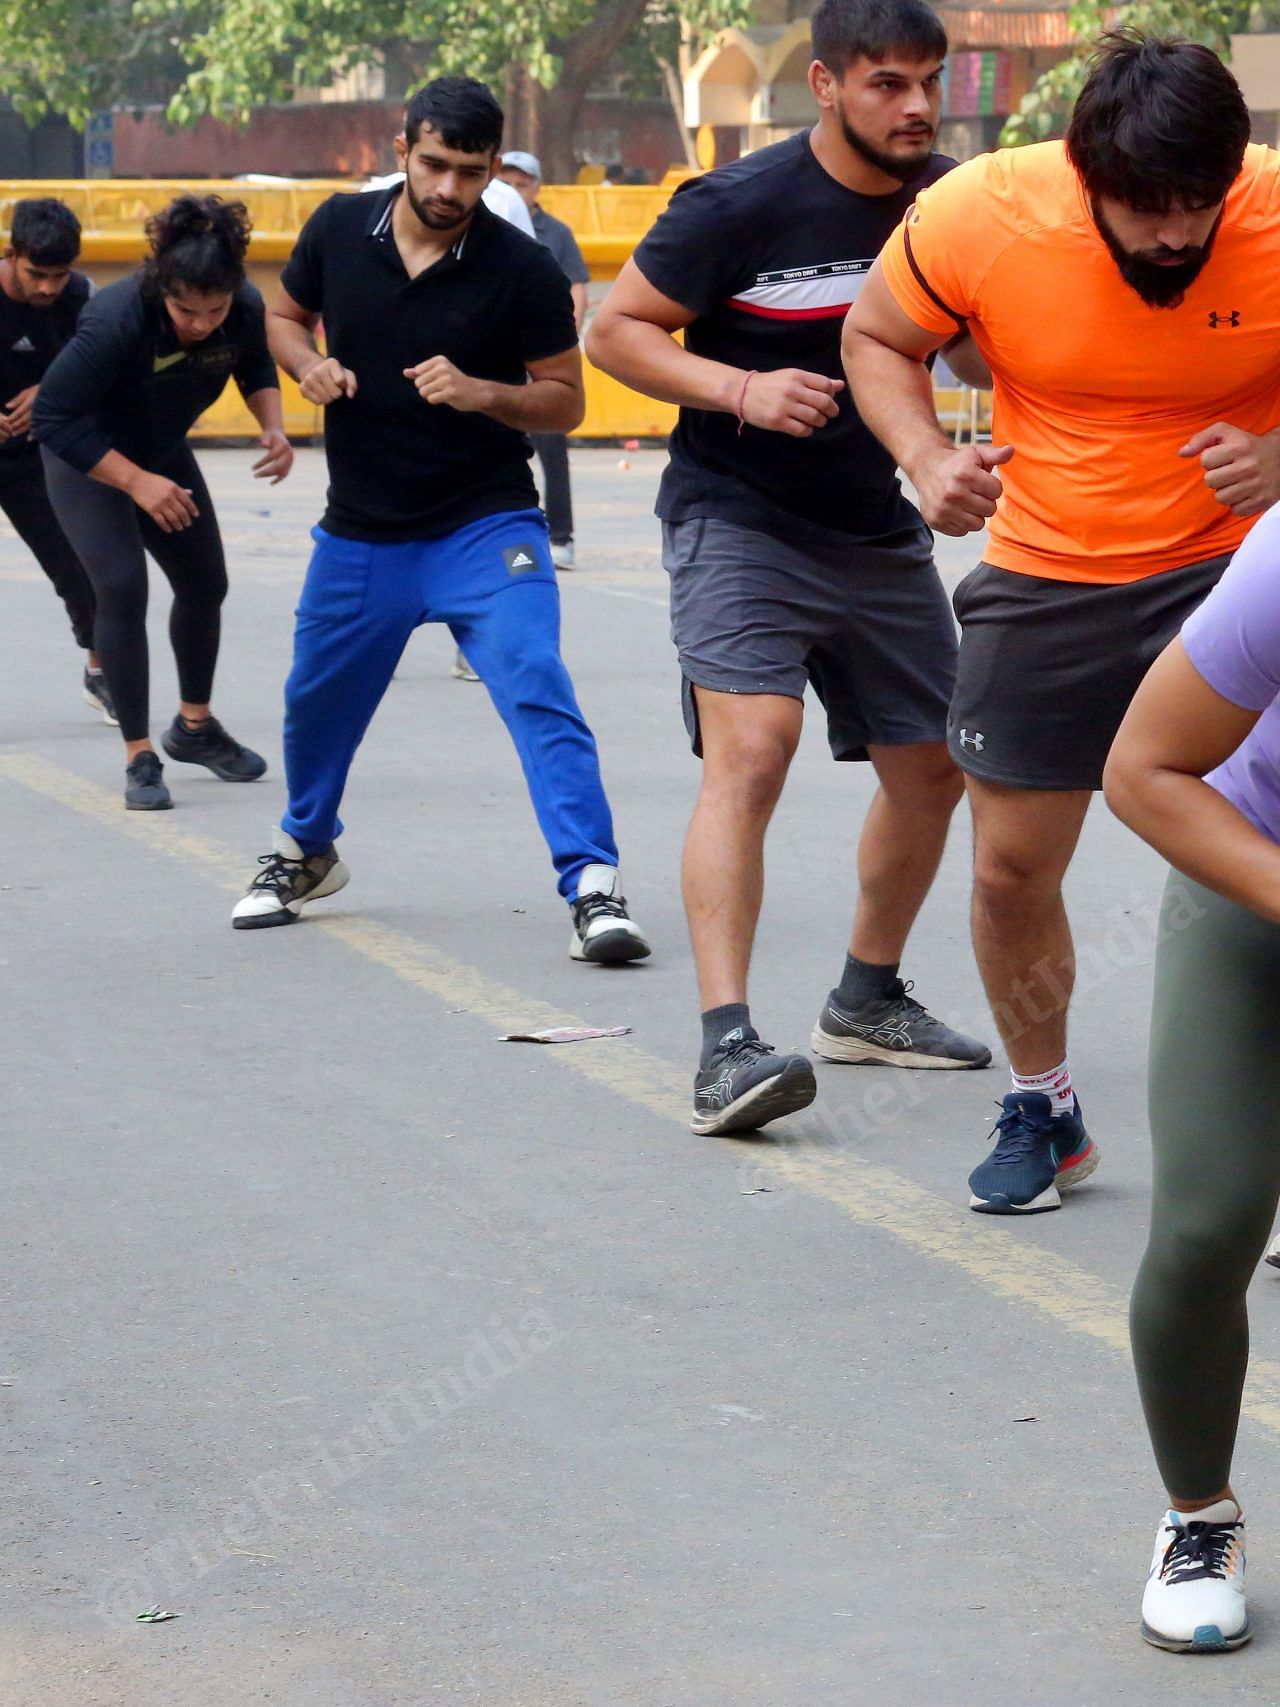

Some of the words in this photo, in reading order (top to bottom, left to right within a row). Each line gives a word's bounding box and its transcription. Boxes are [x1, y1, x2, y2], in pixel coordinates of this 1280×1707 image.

[783, 271, 802, 279] TOKYO
[802, 269, 818, 277] DRIFT
[831, 264, 848, 272] TOKYO
